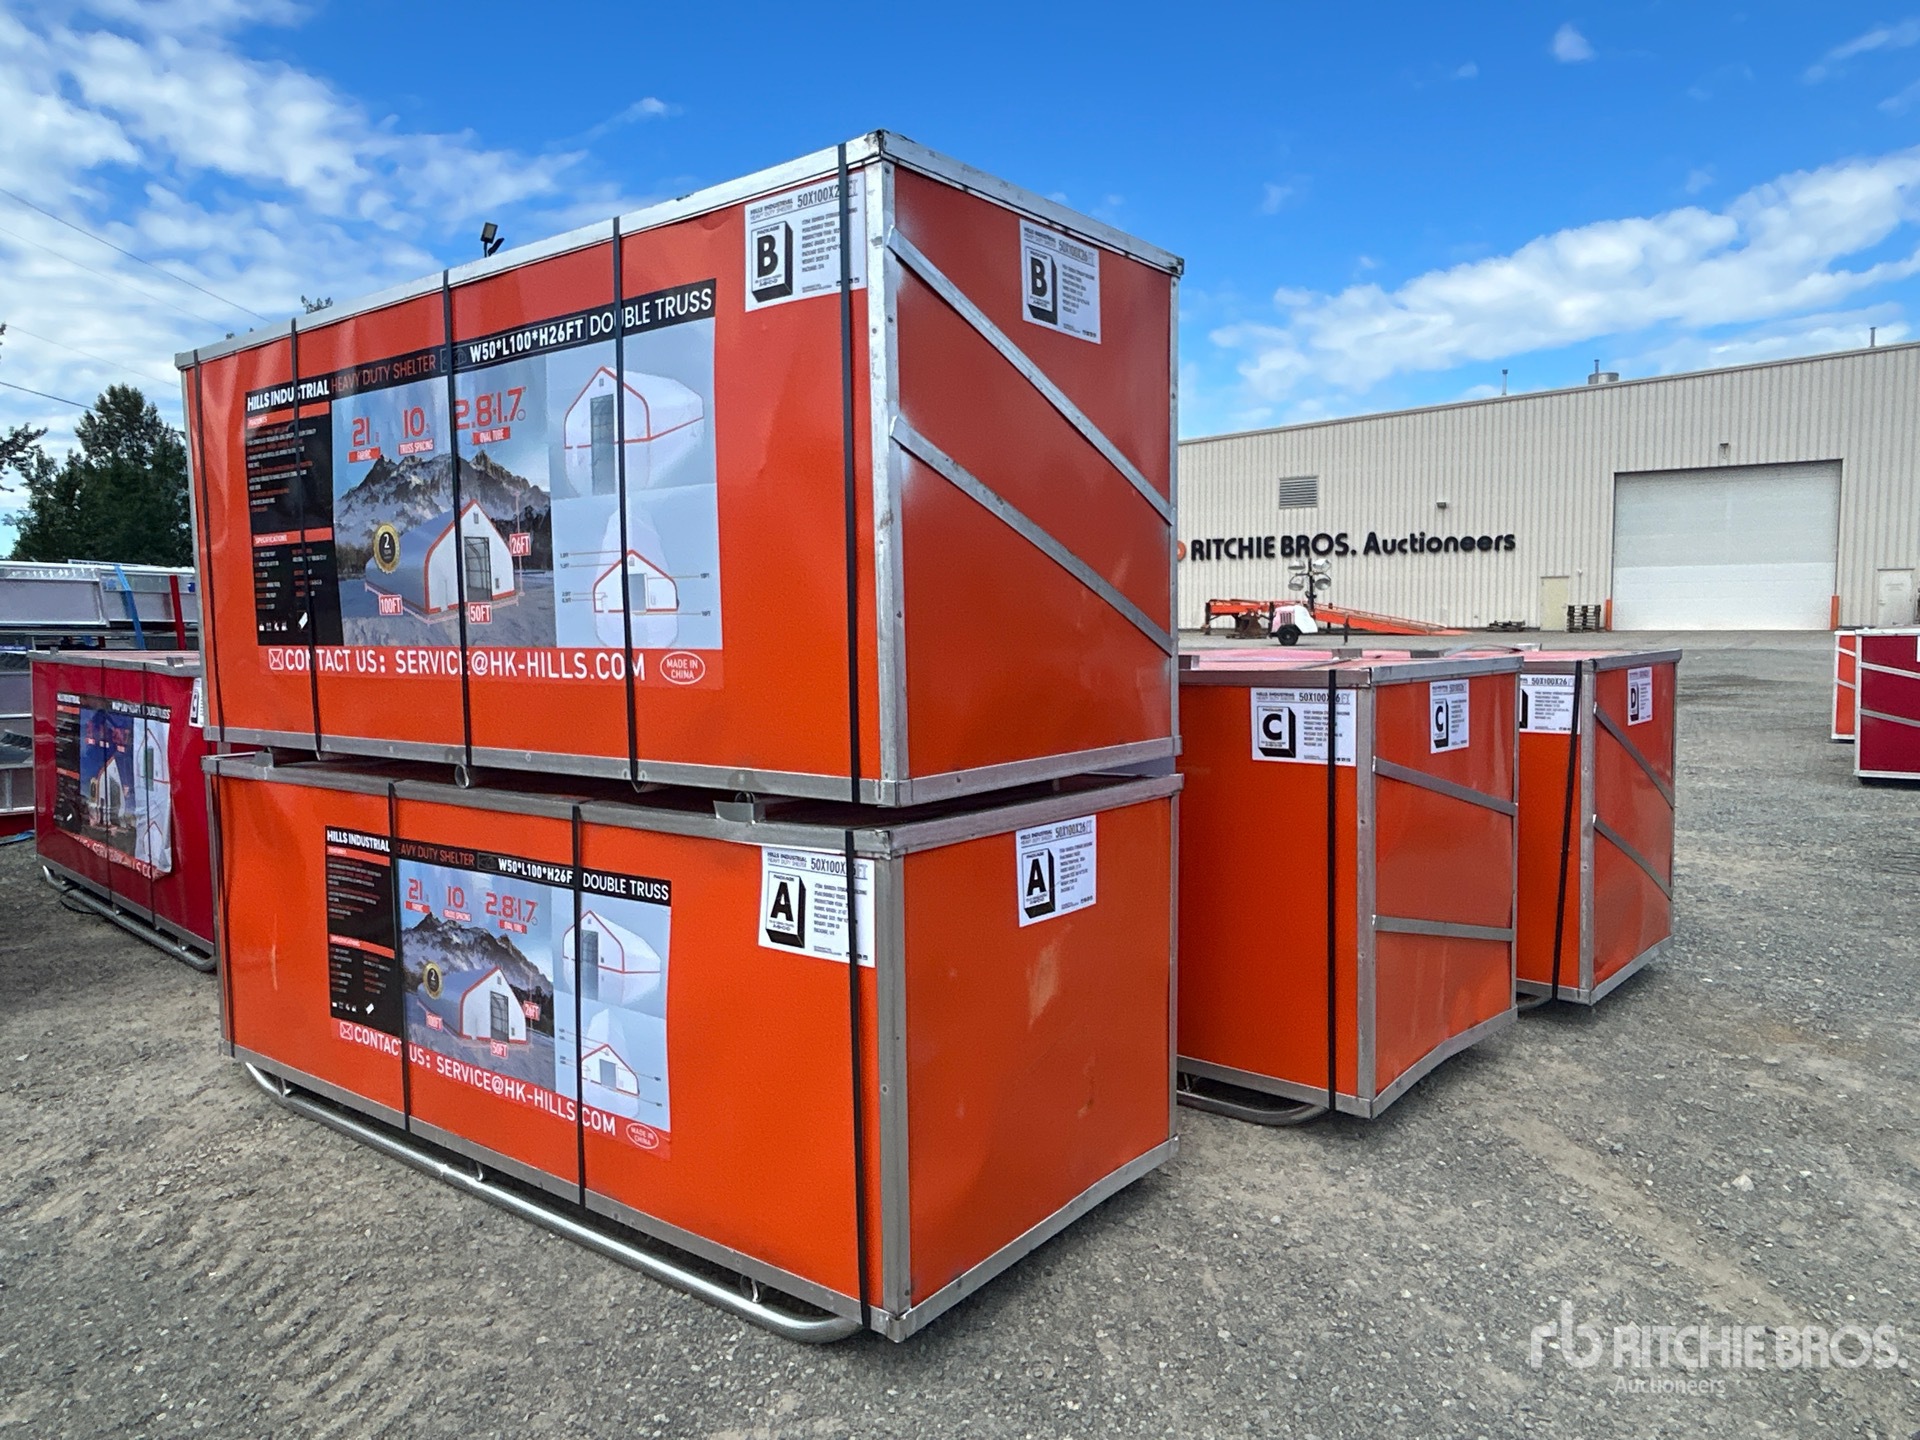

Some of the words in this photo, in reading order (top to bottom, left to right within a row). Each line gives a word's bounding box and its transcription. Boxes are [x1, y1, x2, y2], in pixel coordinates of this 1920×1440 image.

[797, 179, 858, 208] 50X100X2FT
[757, 234, 778, 278] B
[1030, 256, 1048, 298] B
[655, 288, 712, 320] TRUSS
[331, 371, 362, 393] HEAVY
[363, 364, 391, 386] DUTY
[393, 354, 436, 379] SHELTER
[247, 391, 270, 412] HILLS
[352, 417, 370, 446] 21
[404, 406, 425, 438] 10
[383, 533, 390, 549] 2
[512, 536, 531, 554] 26FT
[1191, 535, 1276, 561] RITCHIE
[1280, 532, 1357, 557] BROS.
[1363, 531, 1516, 556] Auctioneers
[380, 596, 402, 614] 100FT
[470, 604, 491, 622] 50FT
[356, 650, 386, 672] US:
[666, 658, 688, 669] MADE
[689, 659, 698, 669] IN
[671, 669, 695, 679] CHINA
[1299, 691, 1350, 703] 50X100X6FT
[1262, 713, 1283, 741] C
[1435, 705, 1444, 732] C
[327, 829, 348, 844] HILLS
[348, 833, 390, 852] INDUSTRIAL
[398, 842, 417, 857] EAVY
[418, 845, 438, 861] DUTY
[440, 849, 475, 866] SHELTER
[498, 857, 573, 884] W50L100H26F
[582, 872, 627, 894] DOUBLE
[629, 879, 669, 901] TRUSS
[811, 858, 868, 879] 50X100XFT
[1026, 858, 1046, 897] A
[408, 878, 423, 900] 21
[447, 886, 465, 909] 10
[770, 881, 794, 922] A
[491, 1042, 507, 1057] 50FT
[354, 1026, 402, 1057] CONTAC
[409, 1044, 431, 1069] US:
[436, 1056, 616, 1136] SERVICE@HK-HILLSCOM
